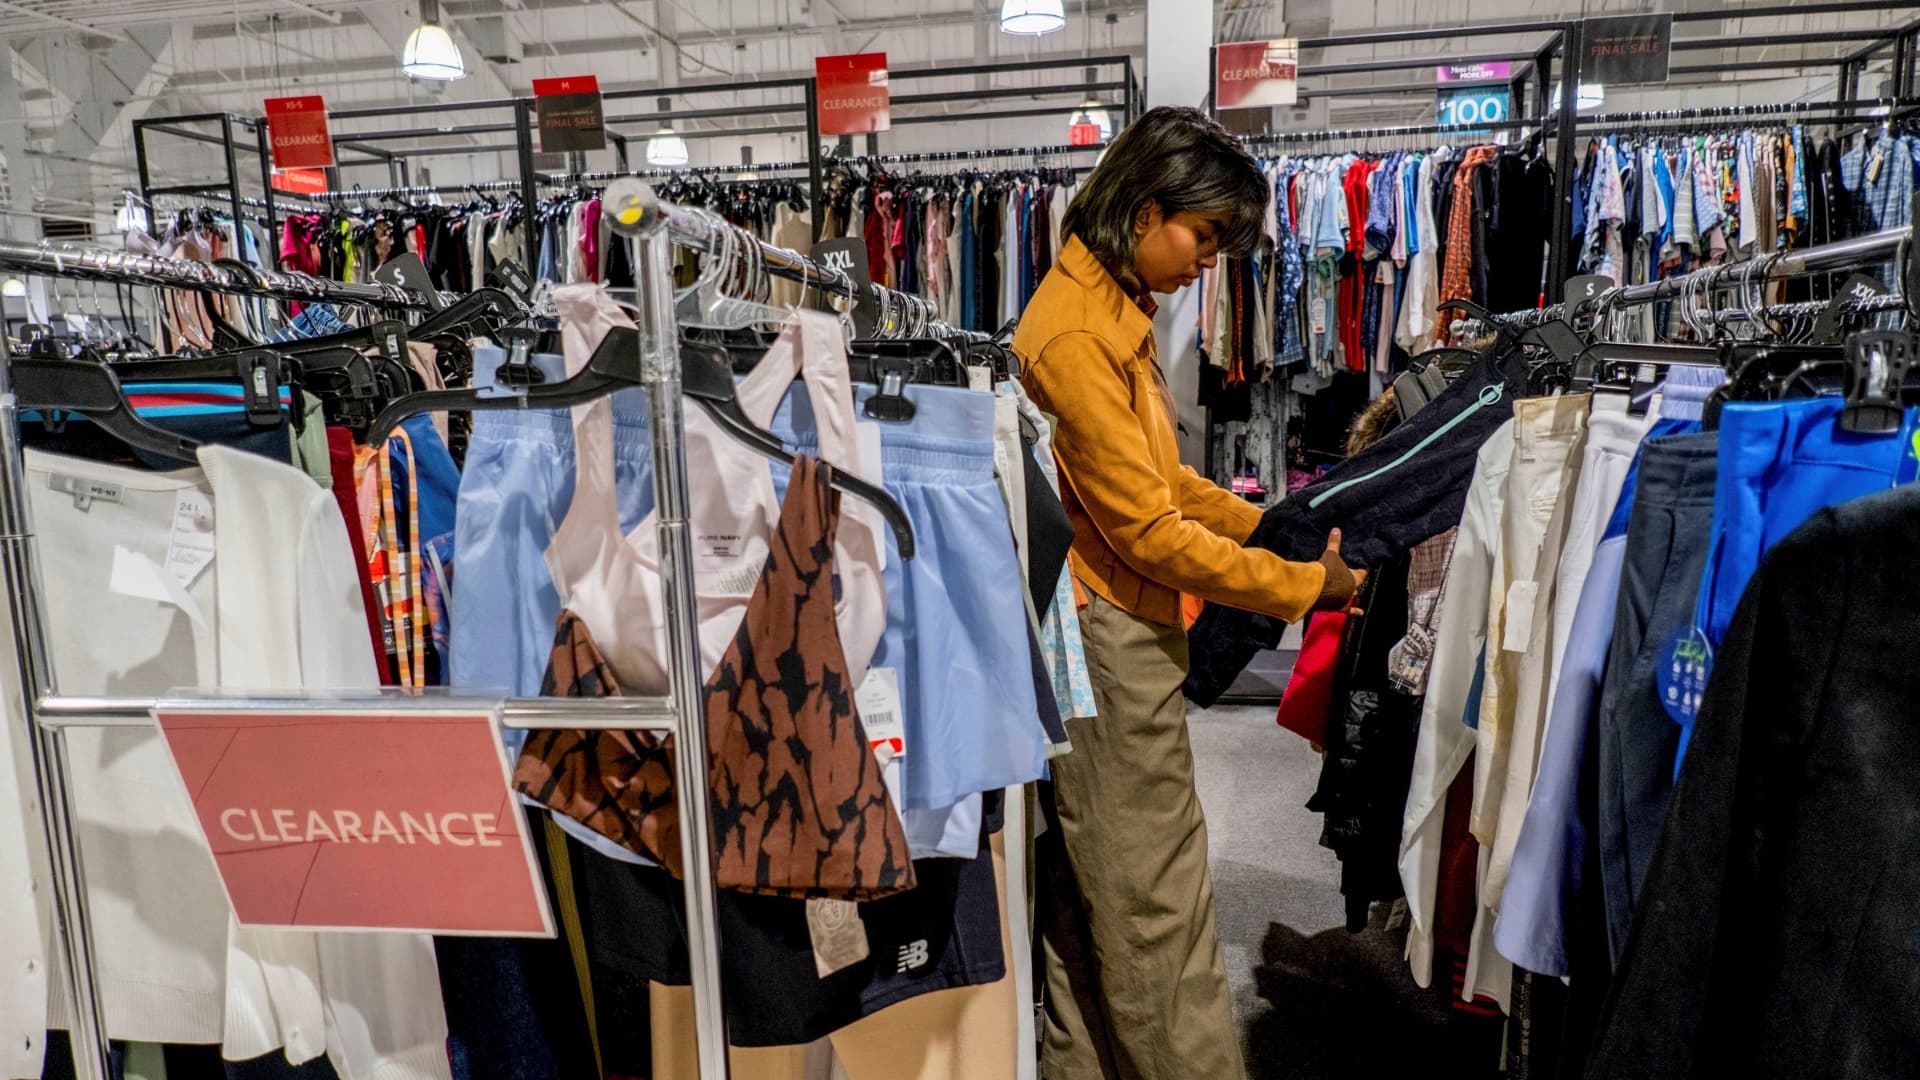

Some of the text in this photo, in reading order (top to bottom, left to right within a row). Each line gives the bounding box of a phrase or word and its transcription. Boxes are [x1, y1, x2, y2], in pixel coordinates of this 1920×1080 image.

[848, 60, 854, 68] L
[1222, 64, 1292, 80] CLEARANCE
[823, 97, 884, 110] CLEARANCE
[1440, 97, 1502, 125] $100
[274, 135, 326, 147] CLEARANCE
[824, 250, 855, 269] XXL
[394, 268, 405, 285] S
[1585, 283, 1595, 296] S
[220, 808, 502, 847] CLEARANCE
